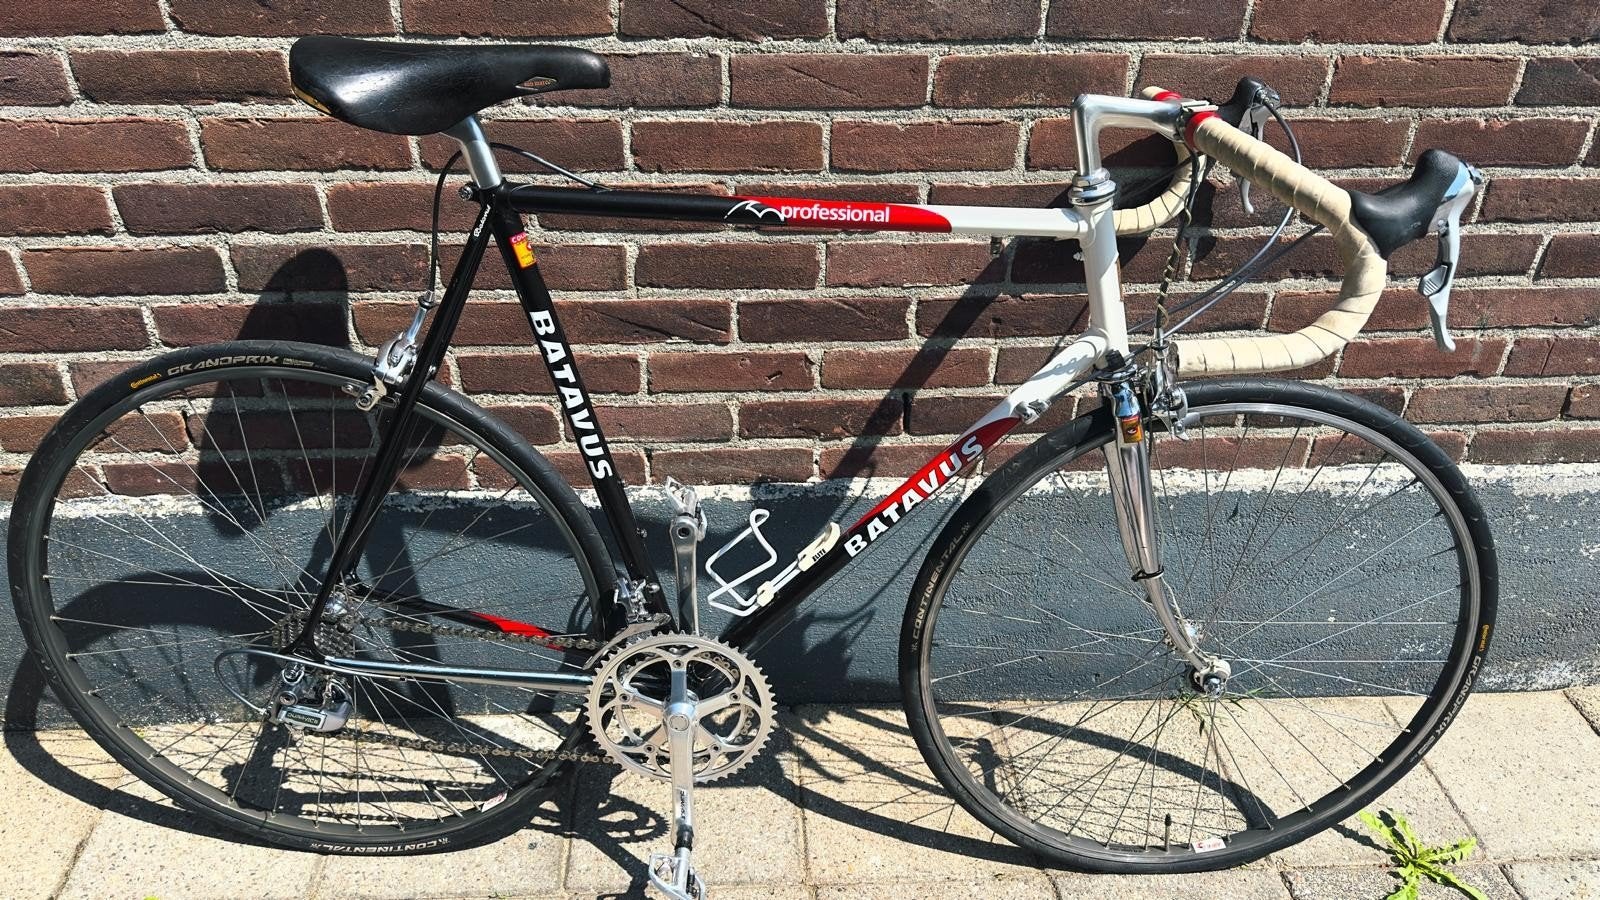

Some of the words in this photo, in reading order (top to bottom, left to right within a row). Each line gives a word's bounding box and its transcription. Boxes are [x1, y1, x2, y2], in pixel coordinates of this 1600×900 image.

[781, 203, 890, 223] professional
[529, 309, 613, 480] BATAVUS
[843, 435, 983, 558] BATAVUS
[912, 533, 964, 640] CONTINENTAL
[322, 840, 438, 853] CONTINENTAL
